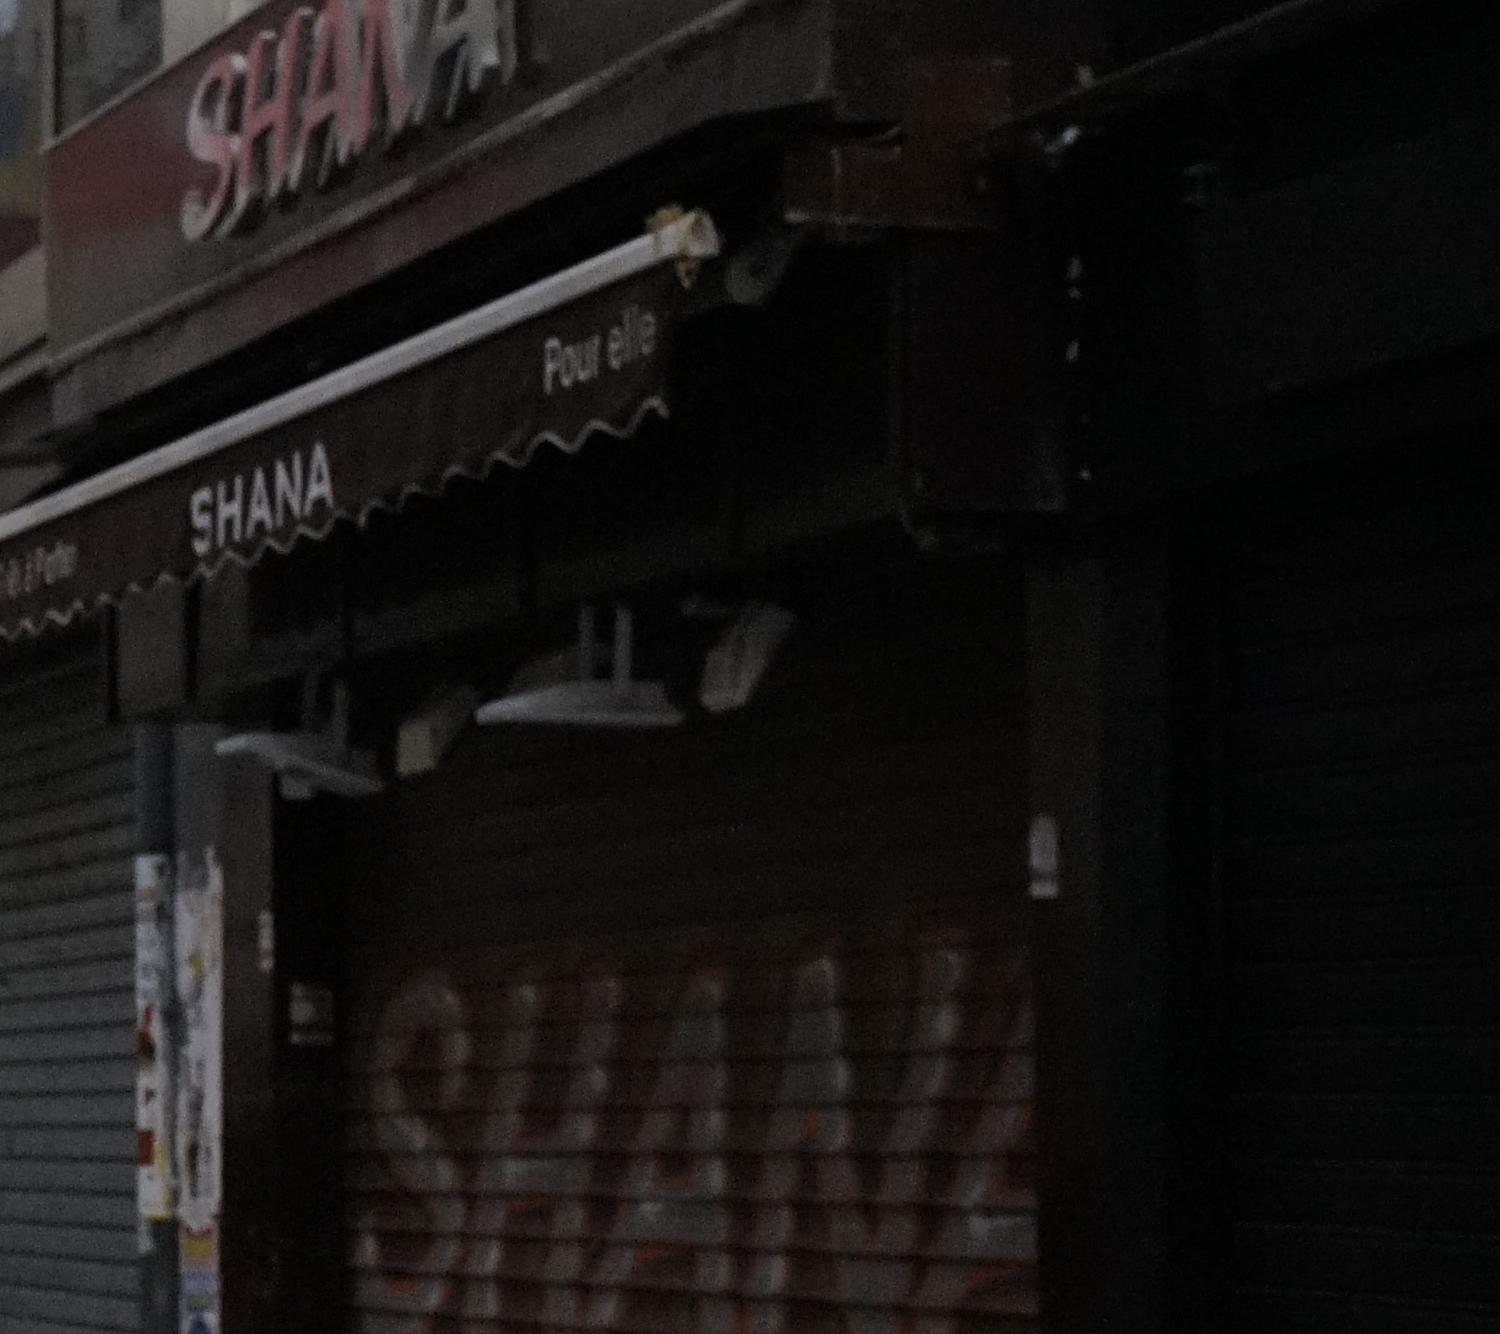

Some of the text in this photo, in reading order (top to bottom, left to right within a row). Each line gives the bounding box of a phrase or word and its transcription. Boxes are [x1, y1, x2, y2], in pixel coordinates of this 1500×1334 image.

[543, 304, 657, 395] Pour elle
[189, 441, 335, 557] SHANA
